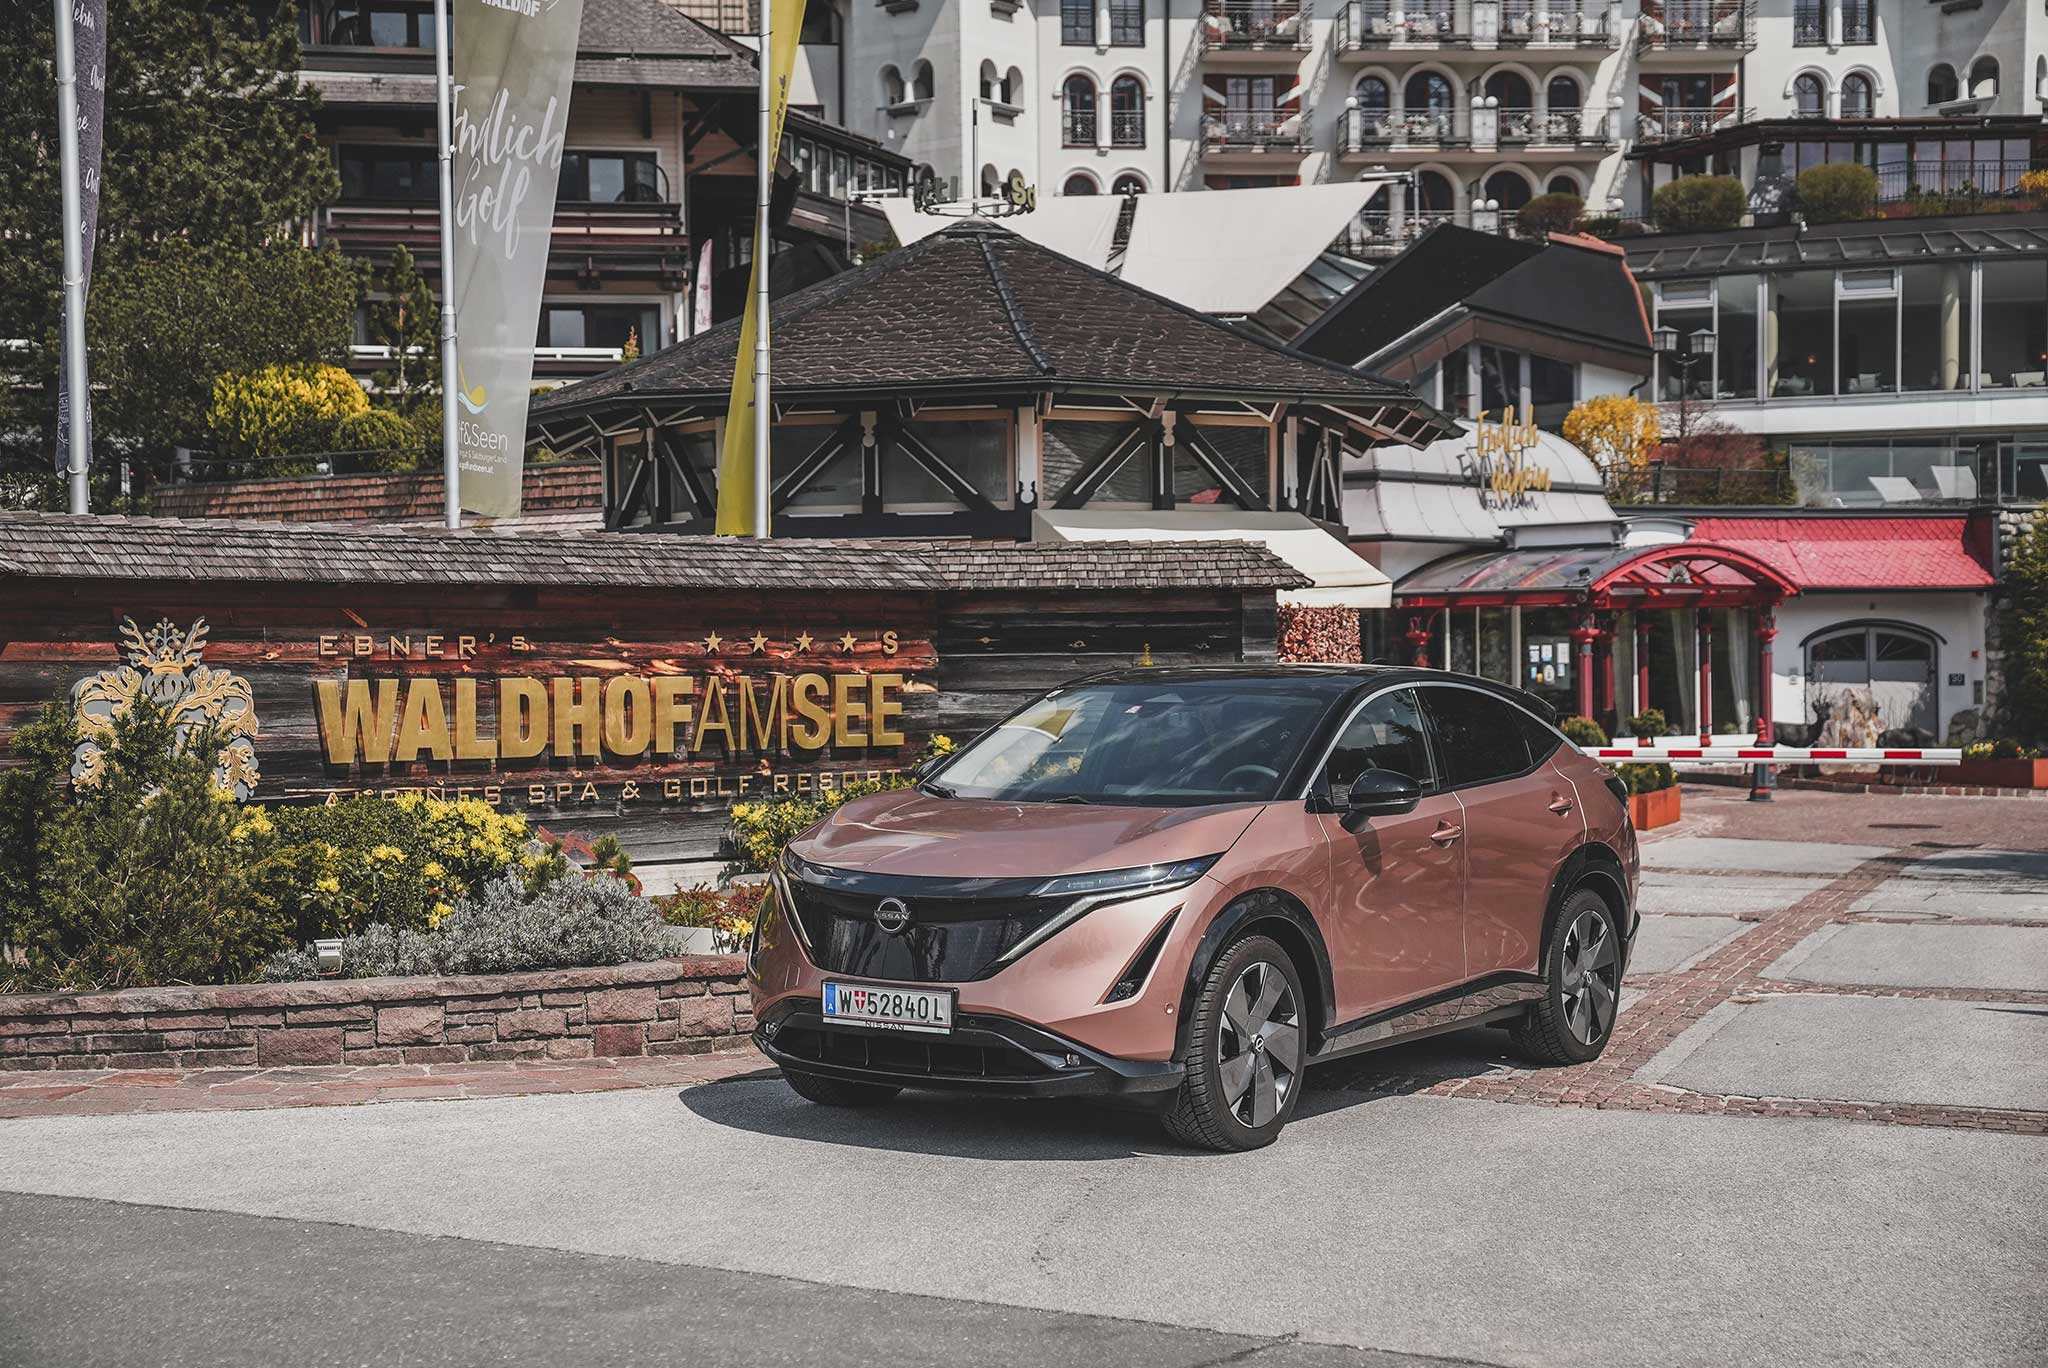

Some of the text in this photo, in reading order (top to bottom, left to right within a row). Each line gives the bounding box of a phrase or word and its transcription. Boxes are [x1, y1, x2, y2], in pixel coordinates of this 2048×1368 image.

[456, 157, 530, 260] Golf
[528, 781, 601, 804] SPA
[622, 780, 641, 799] &
[664, 775, 754, 799] GOLF
[773, 769, 902, 794] RESORT
[873, 910, 911, 921] NISSAN
[839, 989, 852, 1014] W
